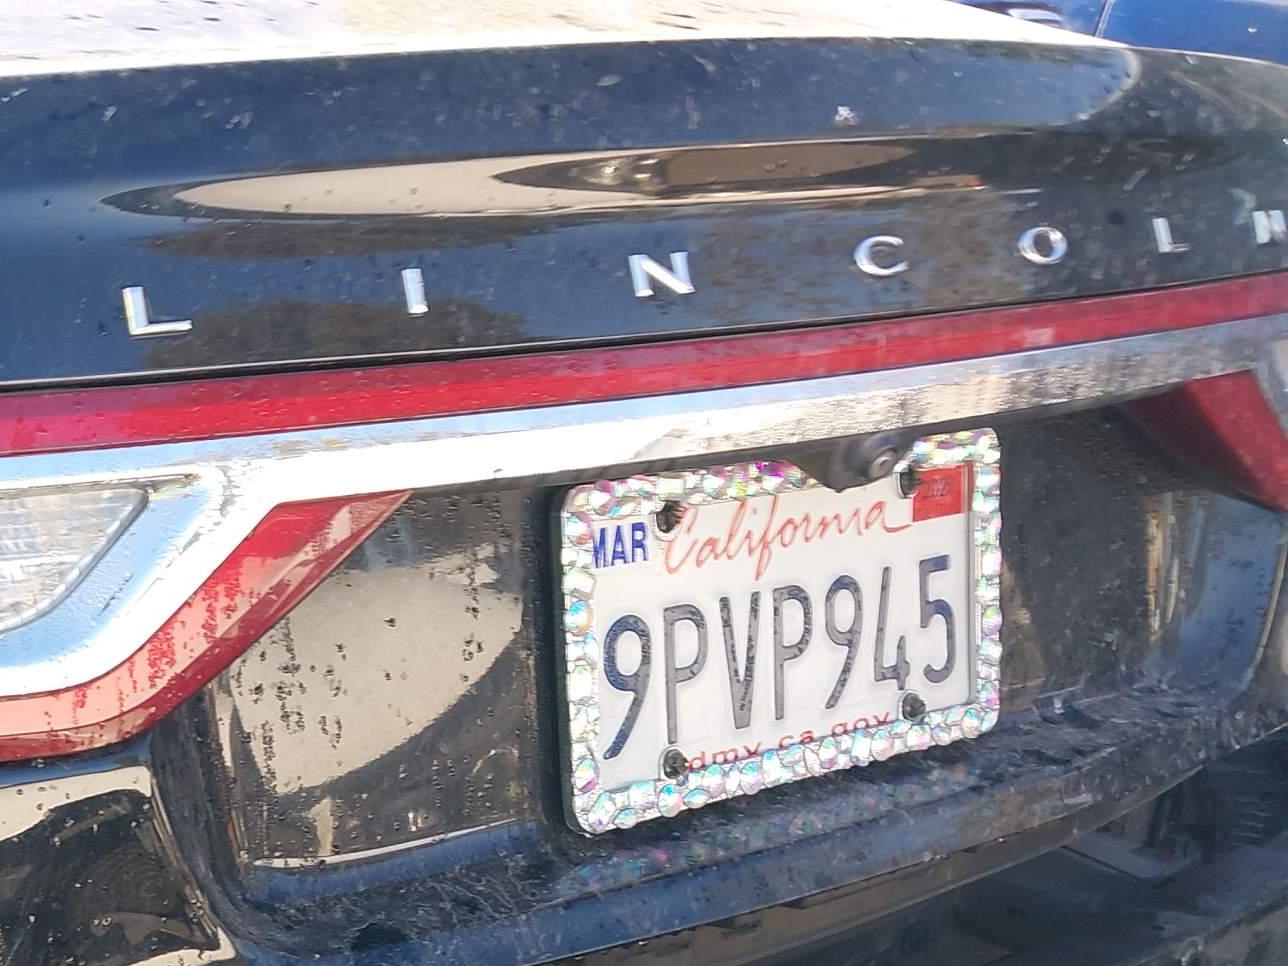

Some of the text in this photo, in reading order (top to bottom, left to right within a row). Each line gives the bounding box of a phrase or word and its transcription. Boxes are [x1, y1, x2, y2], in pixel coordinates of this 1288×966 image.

[122, 209, 1287, 338] LINCOLN
[592, 521, 650, 568] MAR
[664, 495, 913, 581] California
[602, 553, 957, 760] 9PVP945
